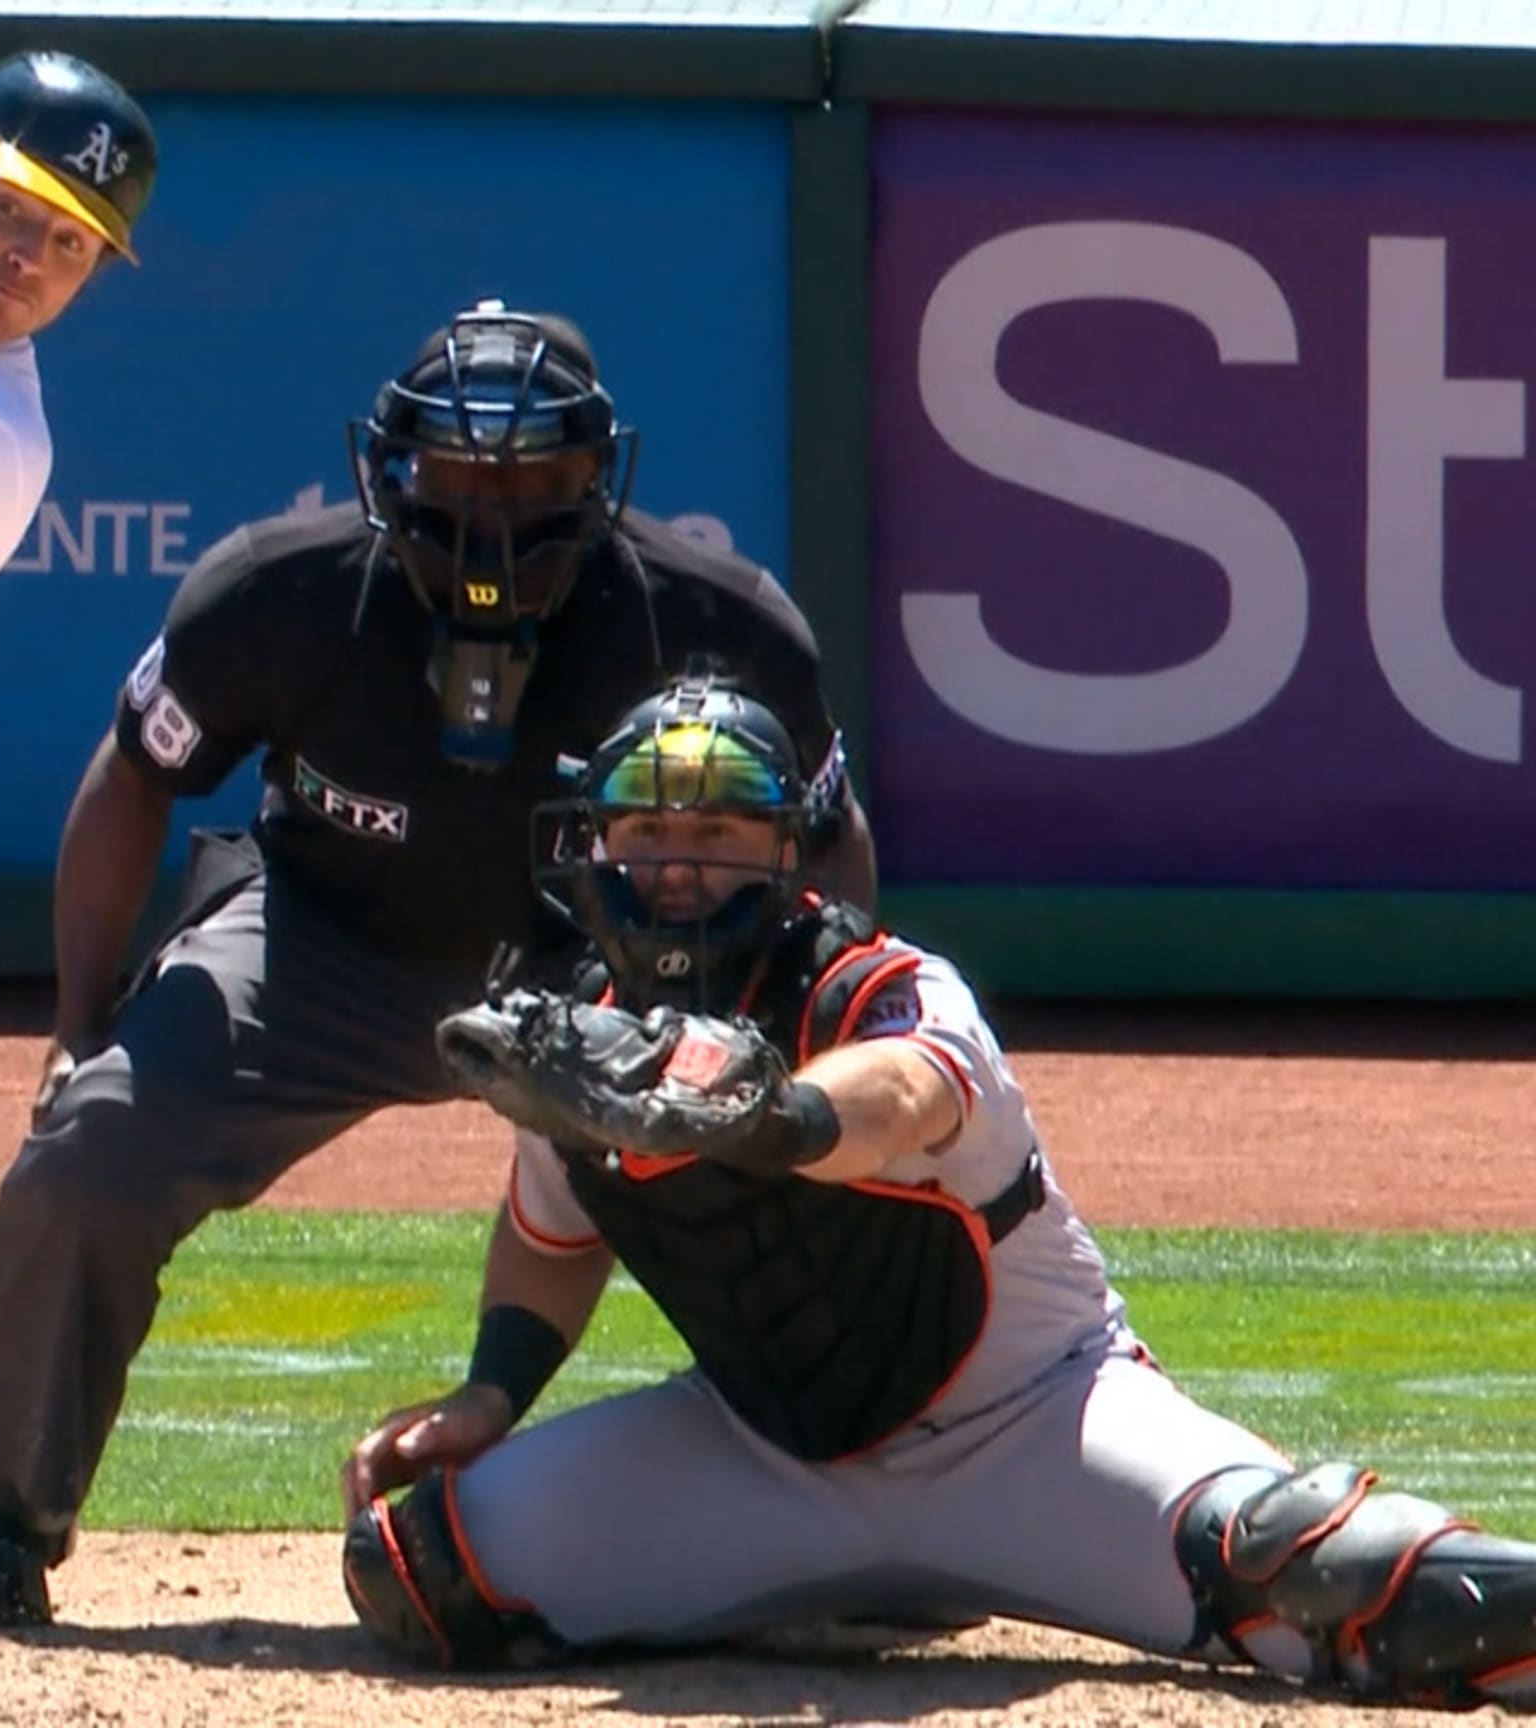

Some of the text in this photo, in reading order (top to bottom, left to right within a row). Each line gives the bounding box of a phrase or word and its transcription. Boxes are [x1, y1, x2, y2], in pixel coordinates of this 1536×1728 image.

[901, 220, 1526, 764] St
[8, 502, 193, 573] NTE
[324, 785, 400, 834] FTX
